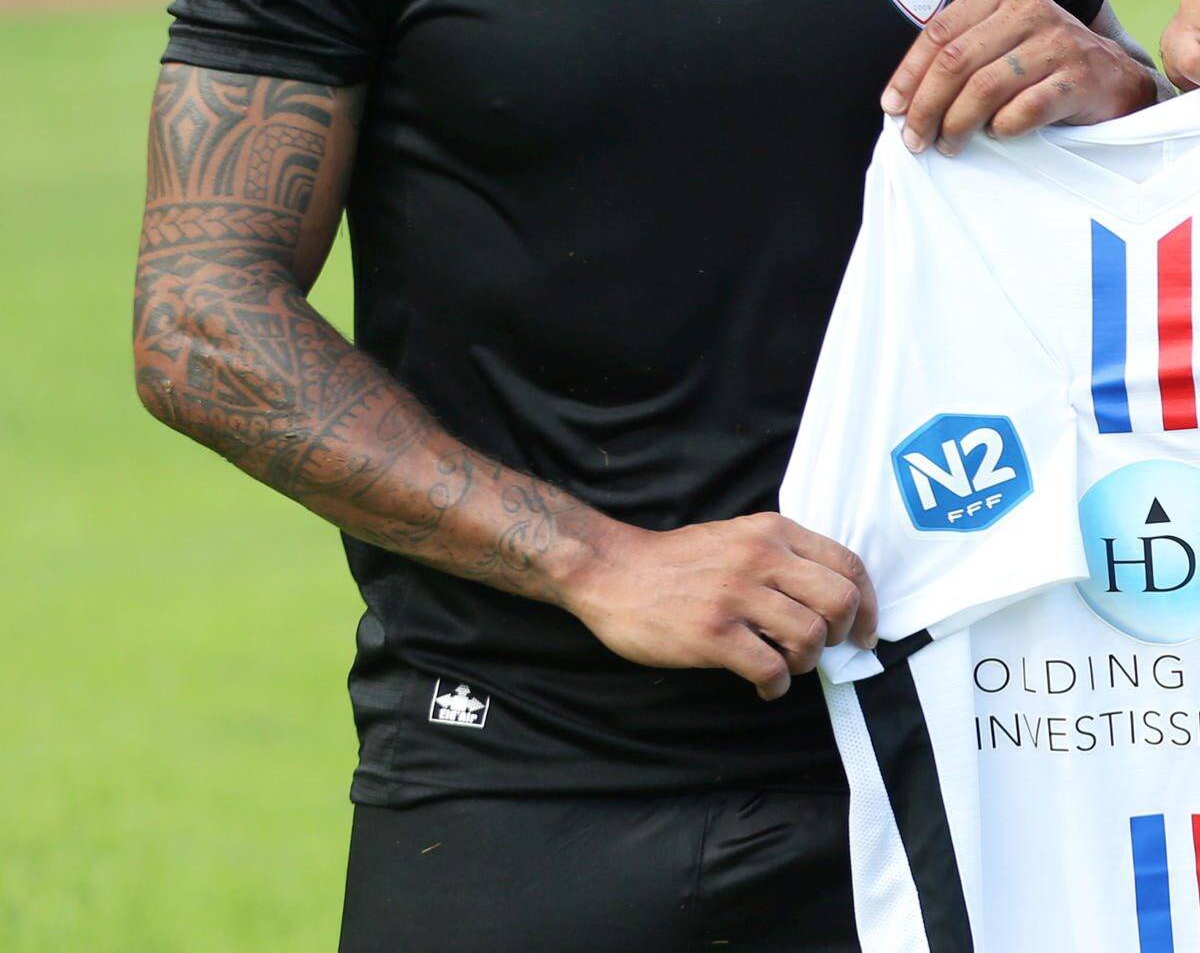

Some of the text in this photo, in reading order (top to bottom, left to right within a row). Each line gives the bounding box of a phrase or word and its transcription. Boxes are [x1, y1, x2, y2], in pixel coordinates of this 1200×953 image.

[902, 427, 1017, 511] N2
[947, 493, 1003, 524] FFF
[973, 654, 1185, 695] OLDING
